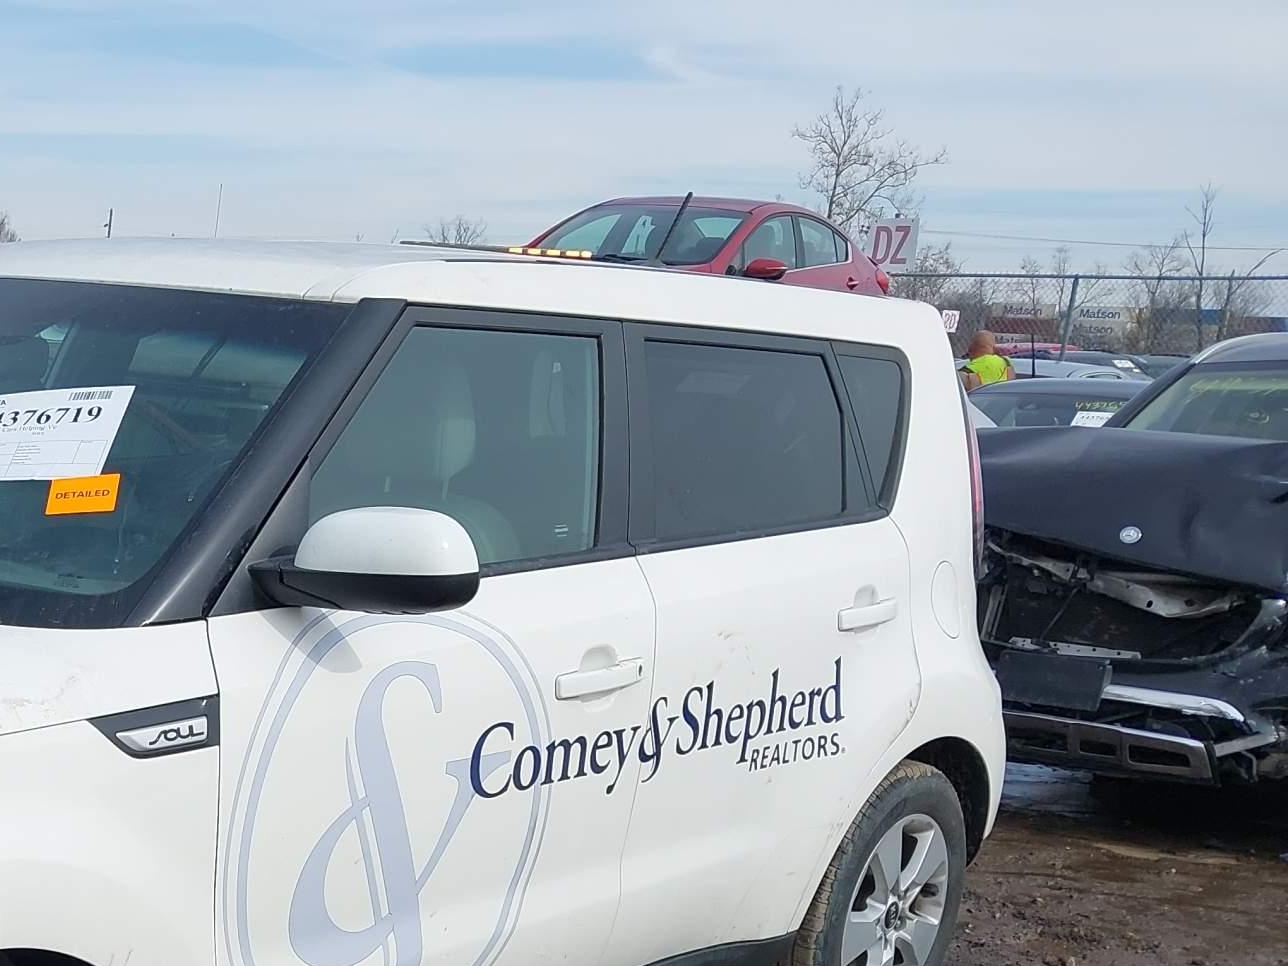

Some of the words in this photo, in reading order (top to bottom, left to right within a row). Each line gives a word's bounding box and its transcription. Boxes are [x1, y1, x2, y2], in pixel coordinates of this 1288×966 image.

[872, 225, 912, 265] DZ
[1003, 304, 1042, 316] Matson
[1079, 308, 1121, 320] Matson
[55, 489, 111, 500] DETAILED
[148, 724, 204, 746] SOUL
[470, 721, 641, 799] Comey
[637, 696, 679, 783] &
[675, 656, 846, 765] Shepherd
